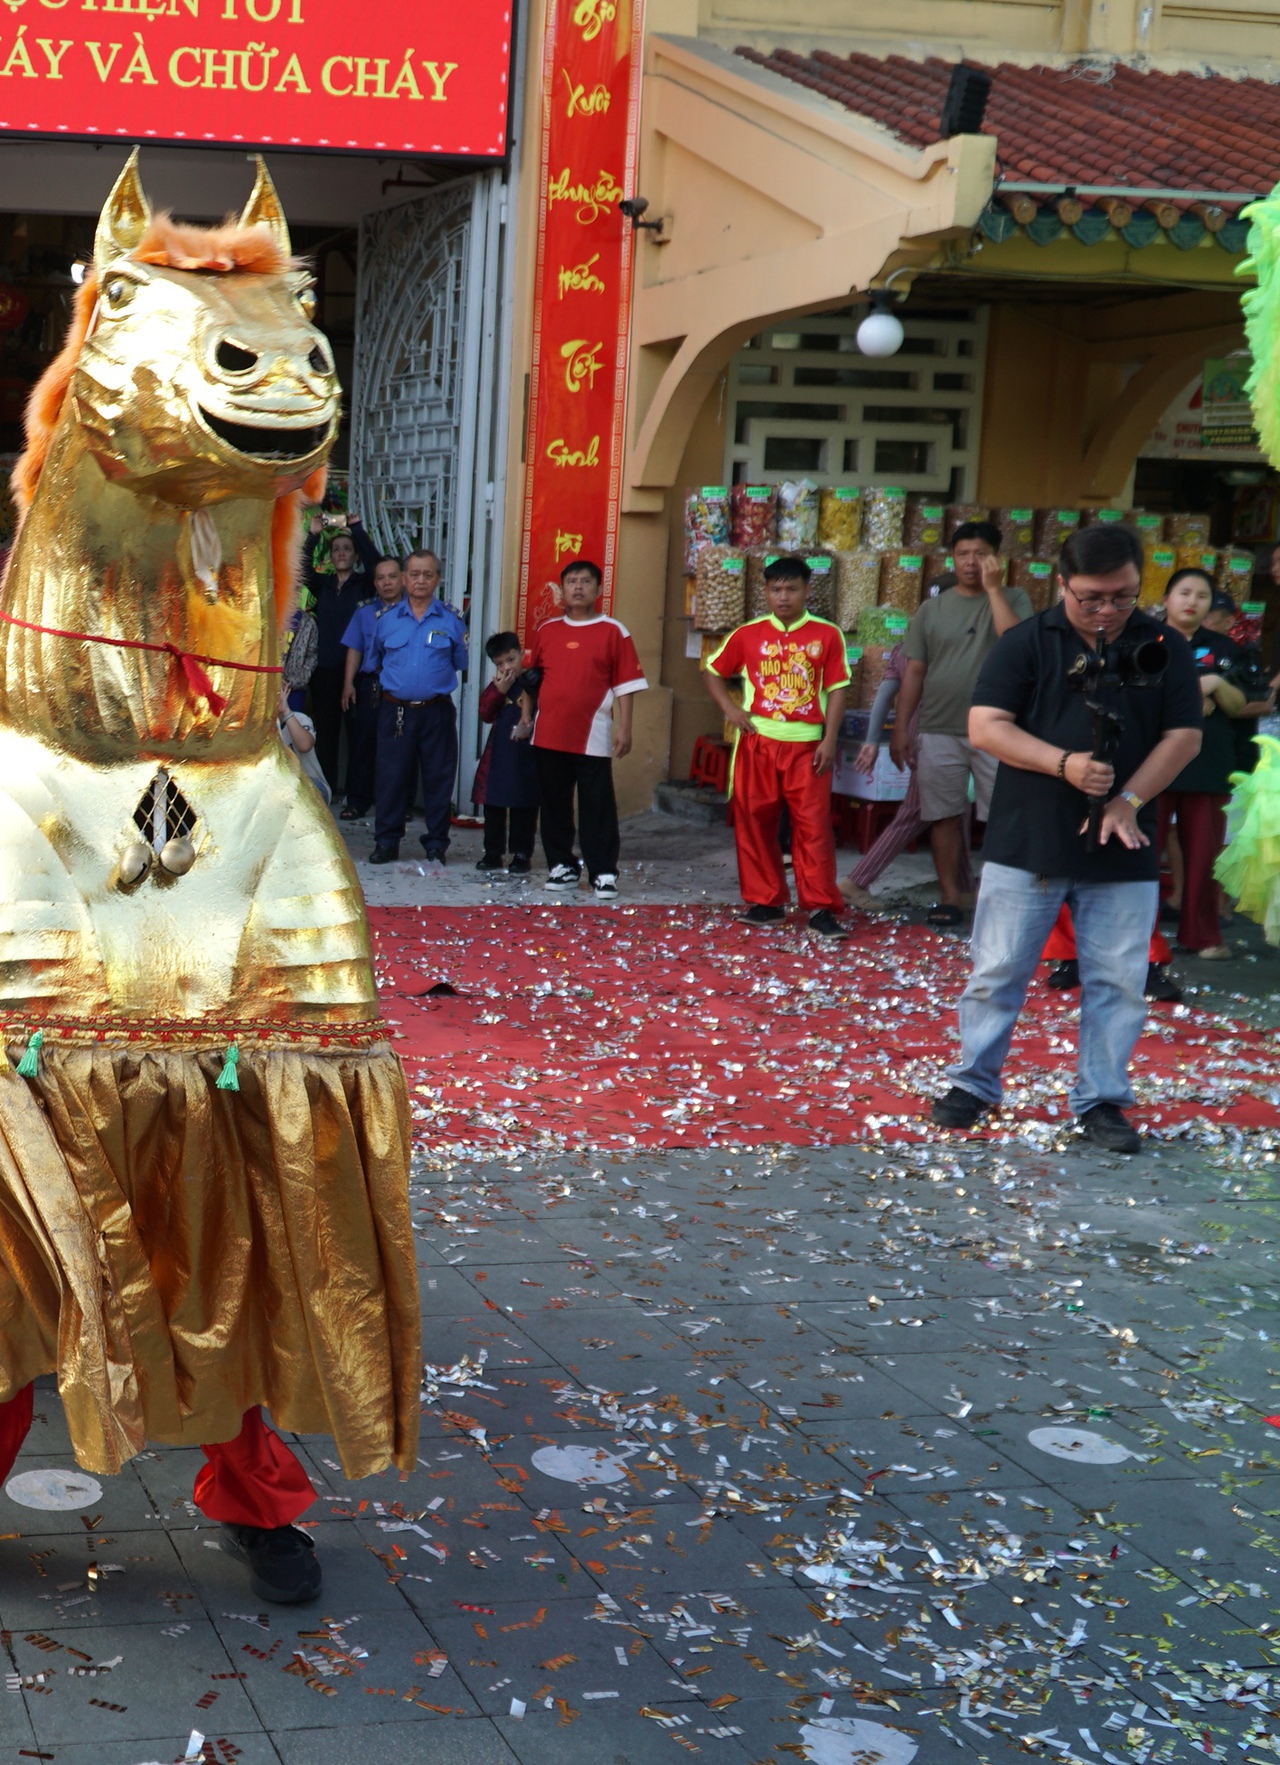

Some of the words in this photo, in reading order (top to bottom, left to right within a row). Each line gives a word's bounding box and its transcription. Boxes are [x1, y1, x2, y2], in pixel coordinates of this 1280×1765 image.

[85, 32, 158, 85] VÀ
[168, 41, 312, 94] CHỮA
[321, 48, 458, 101] CHÁY
[560, 339, 606, 393] Tết
[761, 656, 780, 677] HÀO
